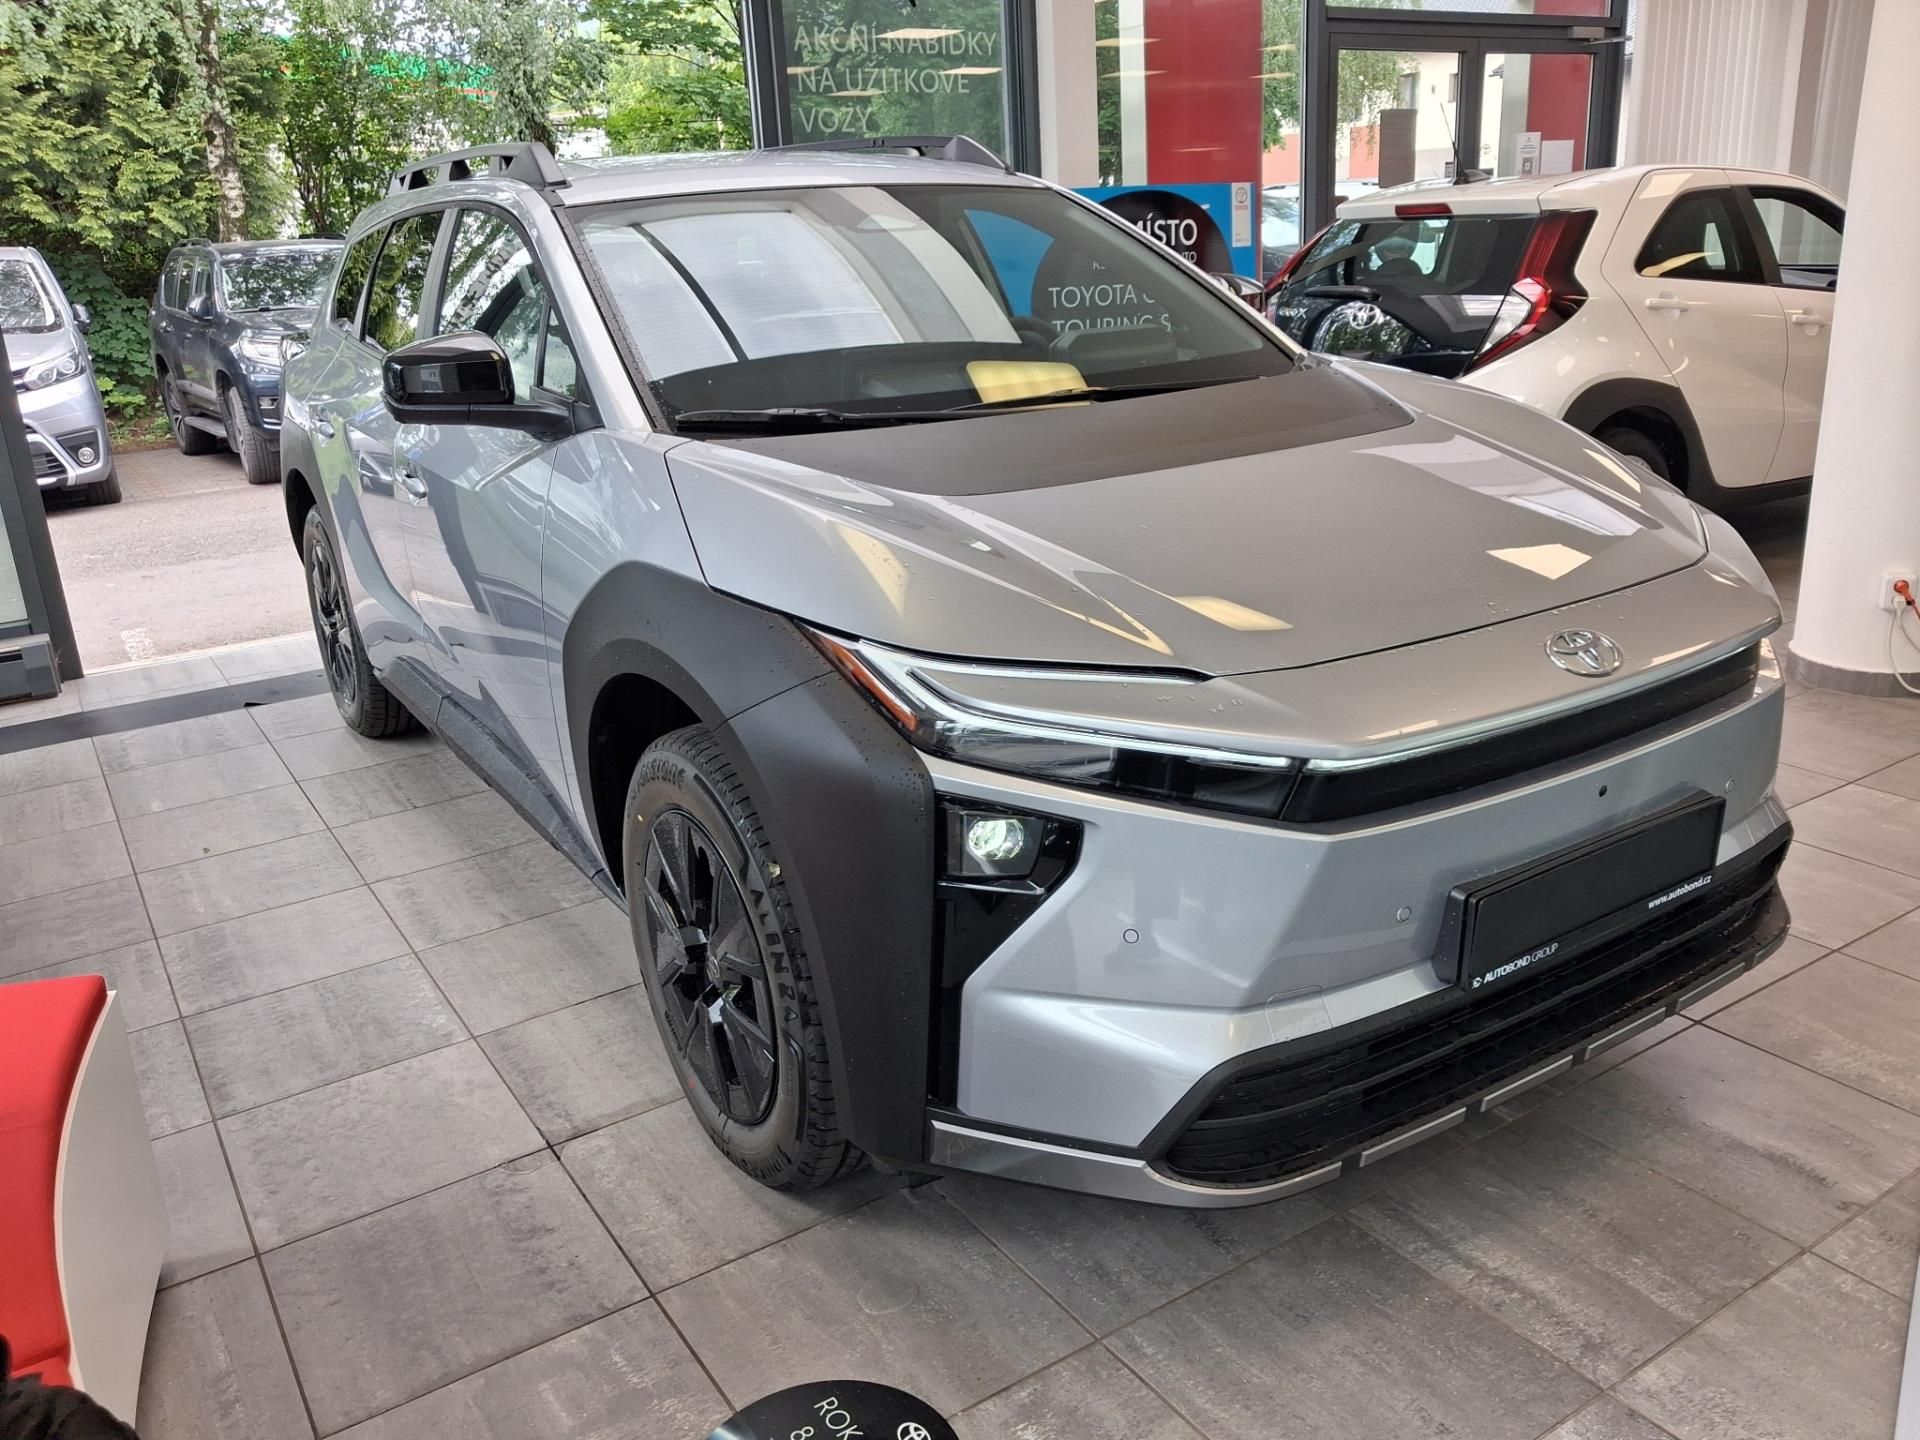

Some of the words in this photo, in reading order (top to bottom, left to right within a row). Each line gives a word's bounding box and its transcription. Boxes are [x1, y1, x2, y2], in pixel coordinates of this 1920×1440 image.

[794, 20, 877, 53] AKČNÍ
[886, 24, 997, 56] NABÍDKY
[798, 67, 837, 92] NA
[798, 106, 872, 133] VOZY
[1136, 212, 1198, 246] ÍSTO
[1048, 284, 1138, 308] TOYOTA
[1648, 875, 1712, 909] www.autobond.cz
[1483, 955, 1531, 984] AUTOBOND
[1531, 942, 1559, 962] GROUP
[813, 1396, 864, 1440] ROK
